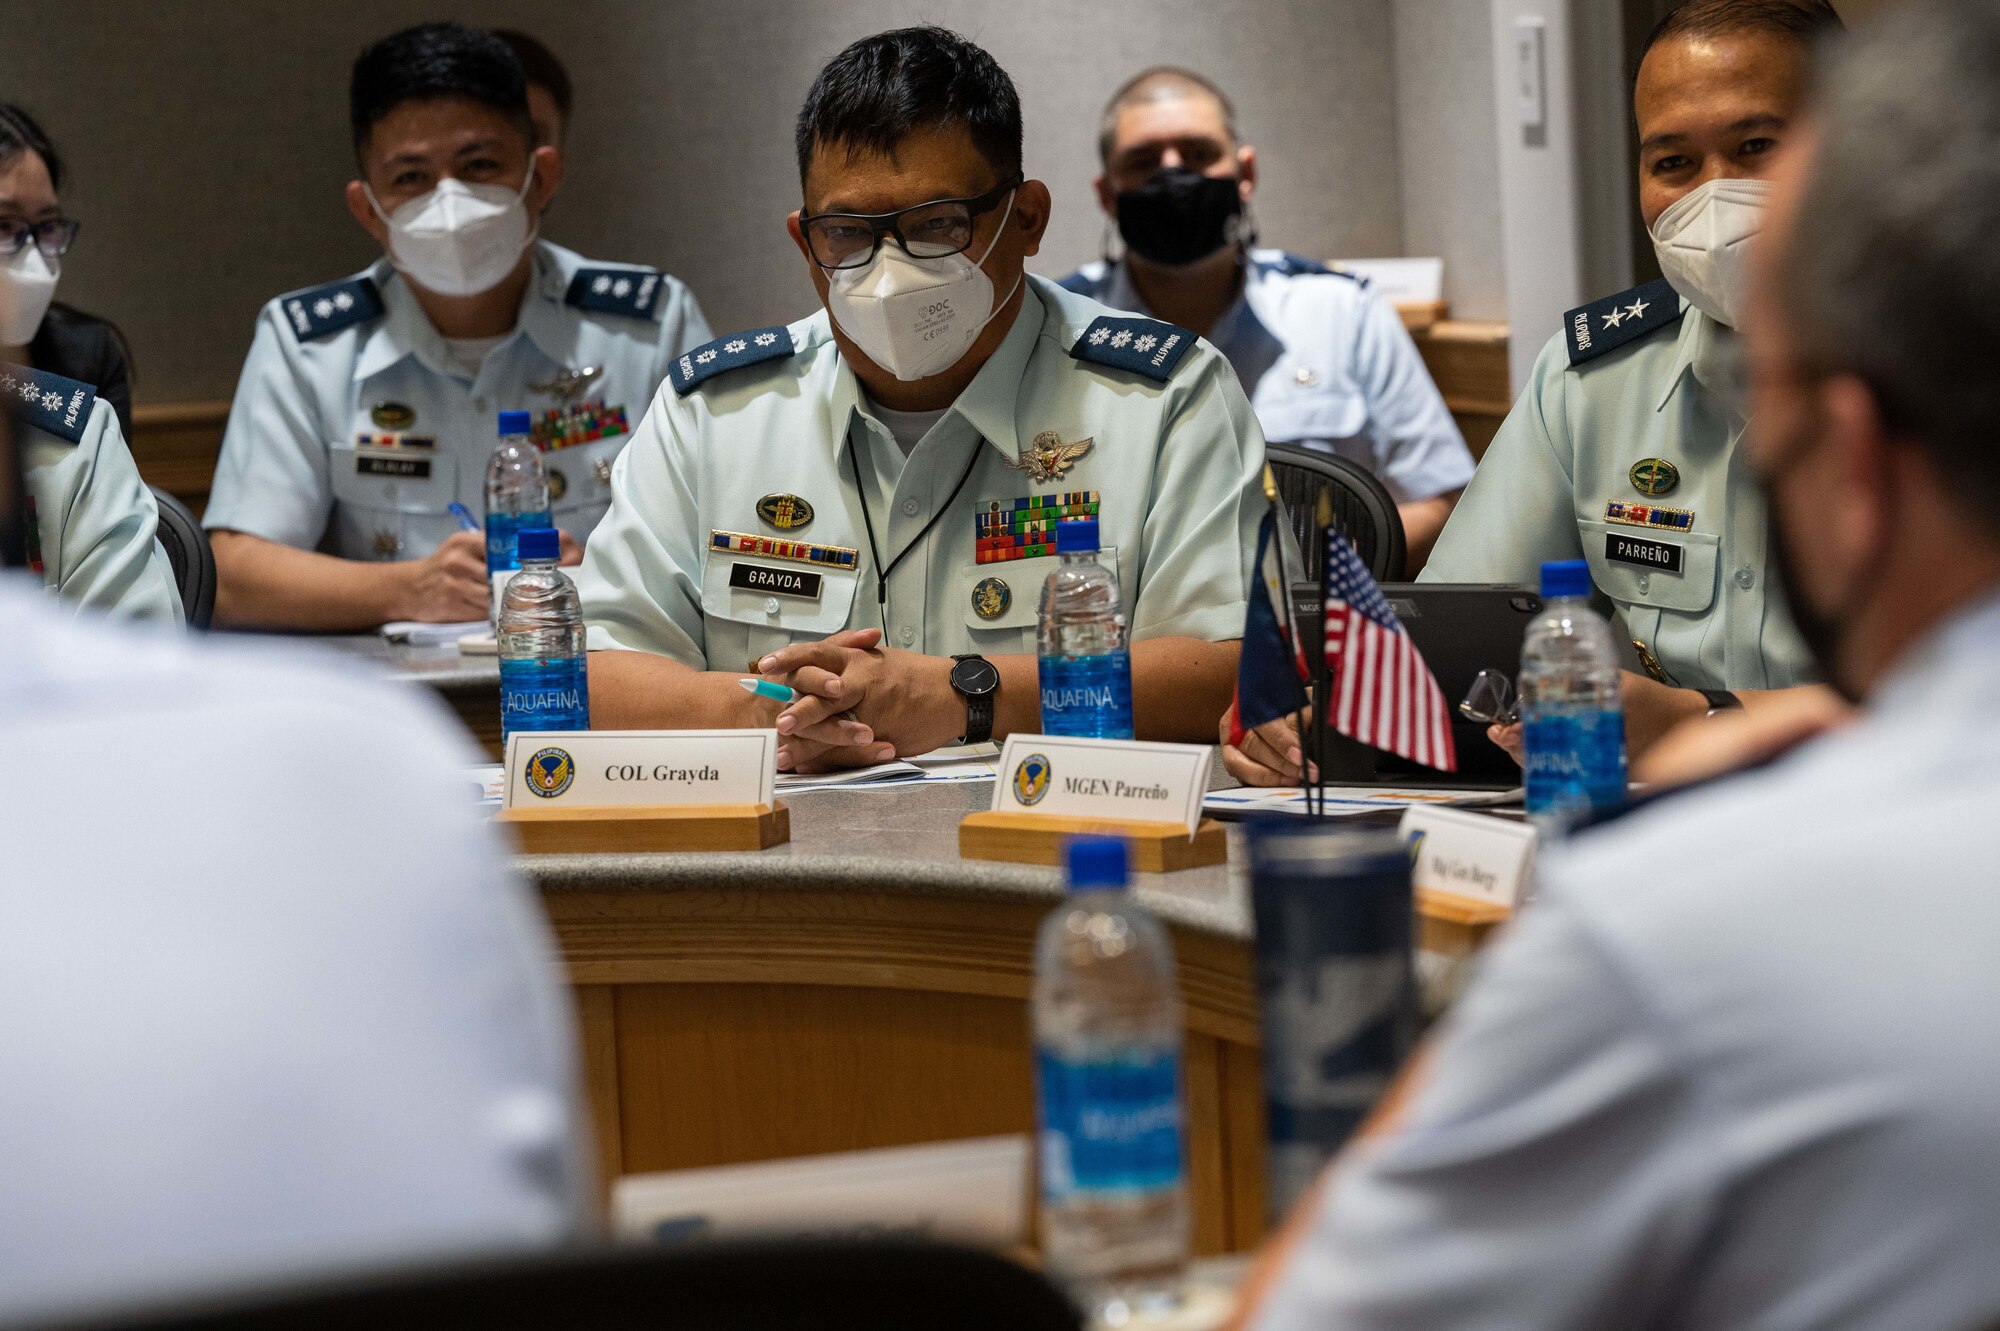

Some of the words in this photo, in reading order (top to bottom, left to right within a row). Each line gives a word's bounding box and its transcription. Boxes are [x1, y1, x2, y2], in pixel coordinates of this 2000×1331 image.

[1618, 541, 1669, 563] PARREÑO
[748, 571, 801, 589] GRAYDA
[506, 688, 581, 714] AQUAFINA
[605, 765, 648, 781] COL
[653, 765, 719, 785] Grayda
[1062, 777, 1111, 796] MGEN
[1114, 782, 1169, 801] Parreño
